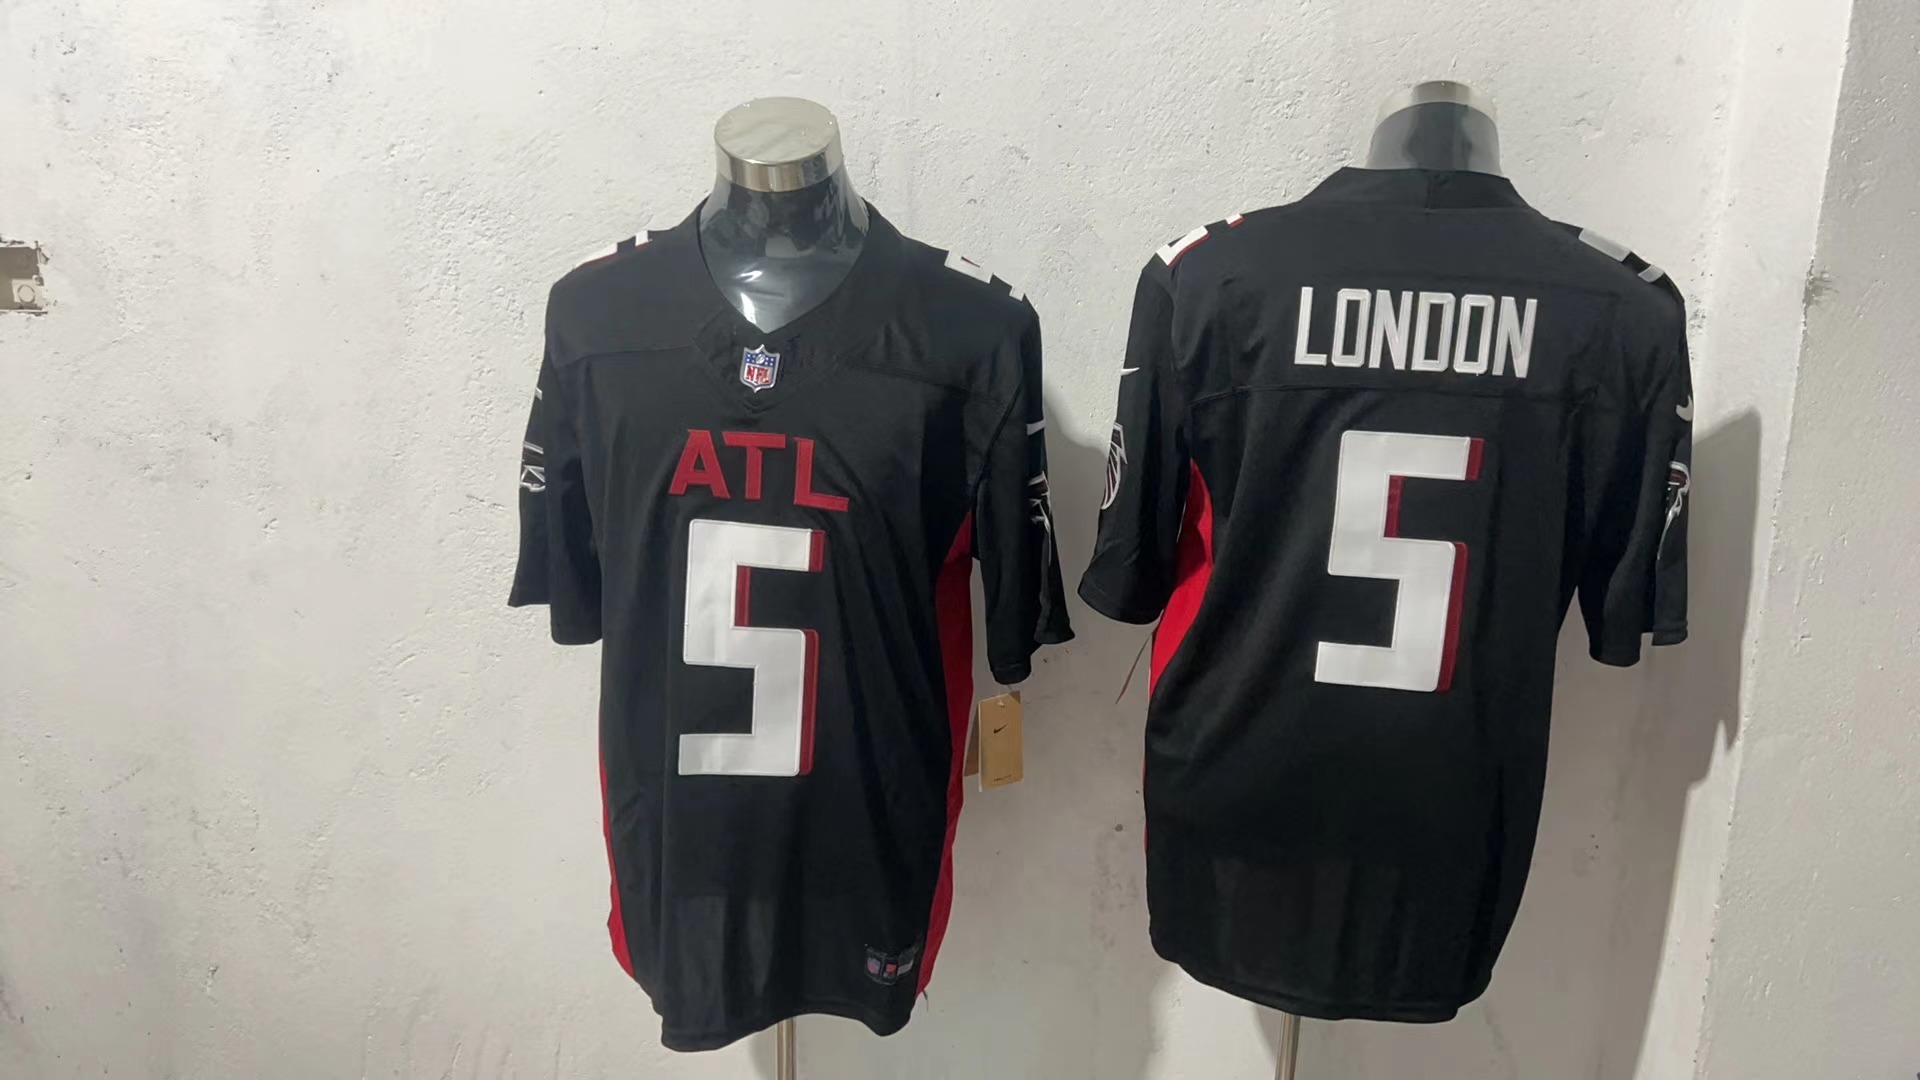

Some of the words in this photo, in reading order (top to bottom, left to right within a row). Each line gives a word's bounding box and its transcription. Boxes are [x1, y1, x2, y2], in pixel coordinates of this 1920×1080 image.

[745, 364, 771, 384] NFL
[1294, 287, 1538, 378] LONDON
[668, 429, 850, 512] ATL
[1314, 430, 1485, 692] 5
[678, 519, 825, 776] 5
